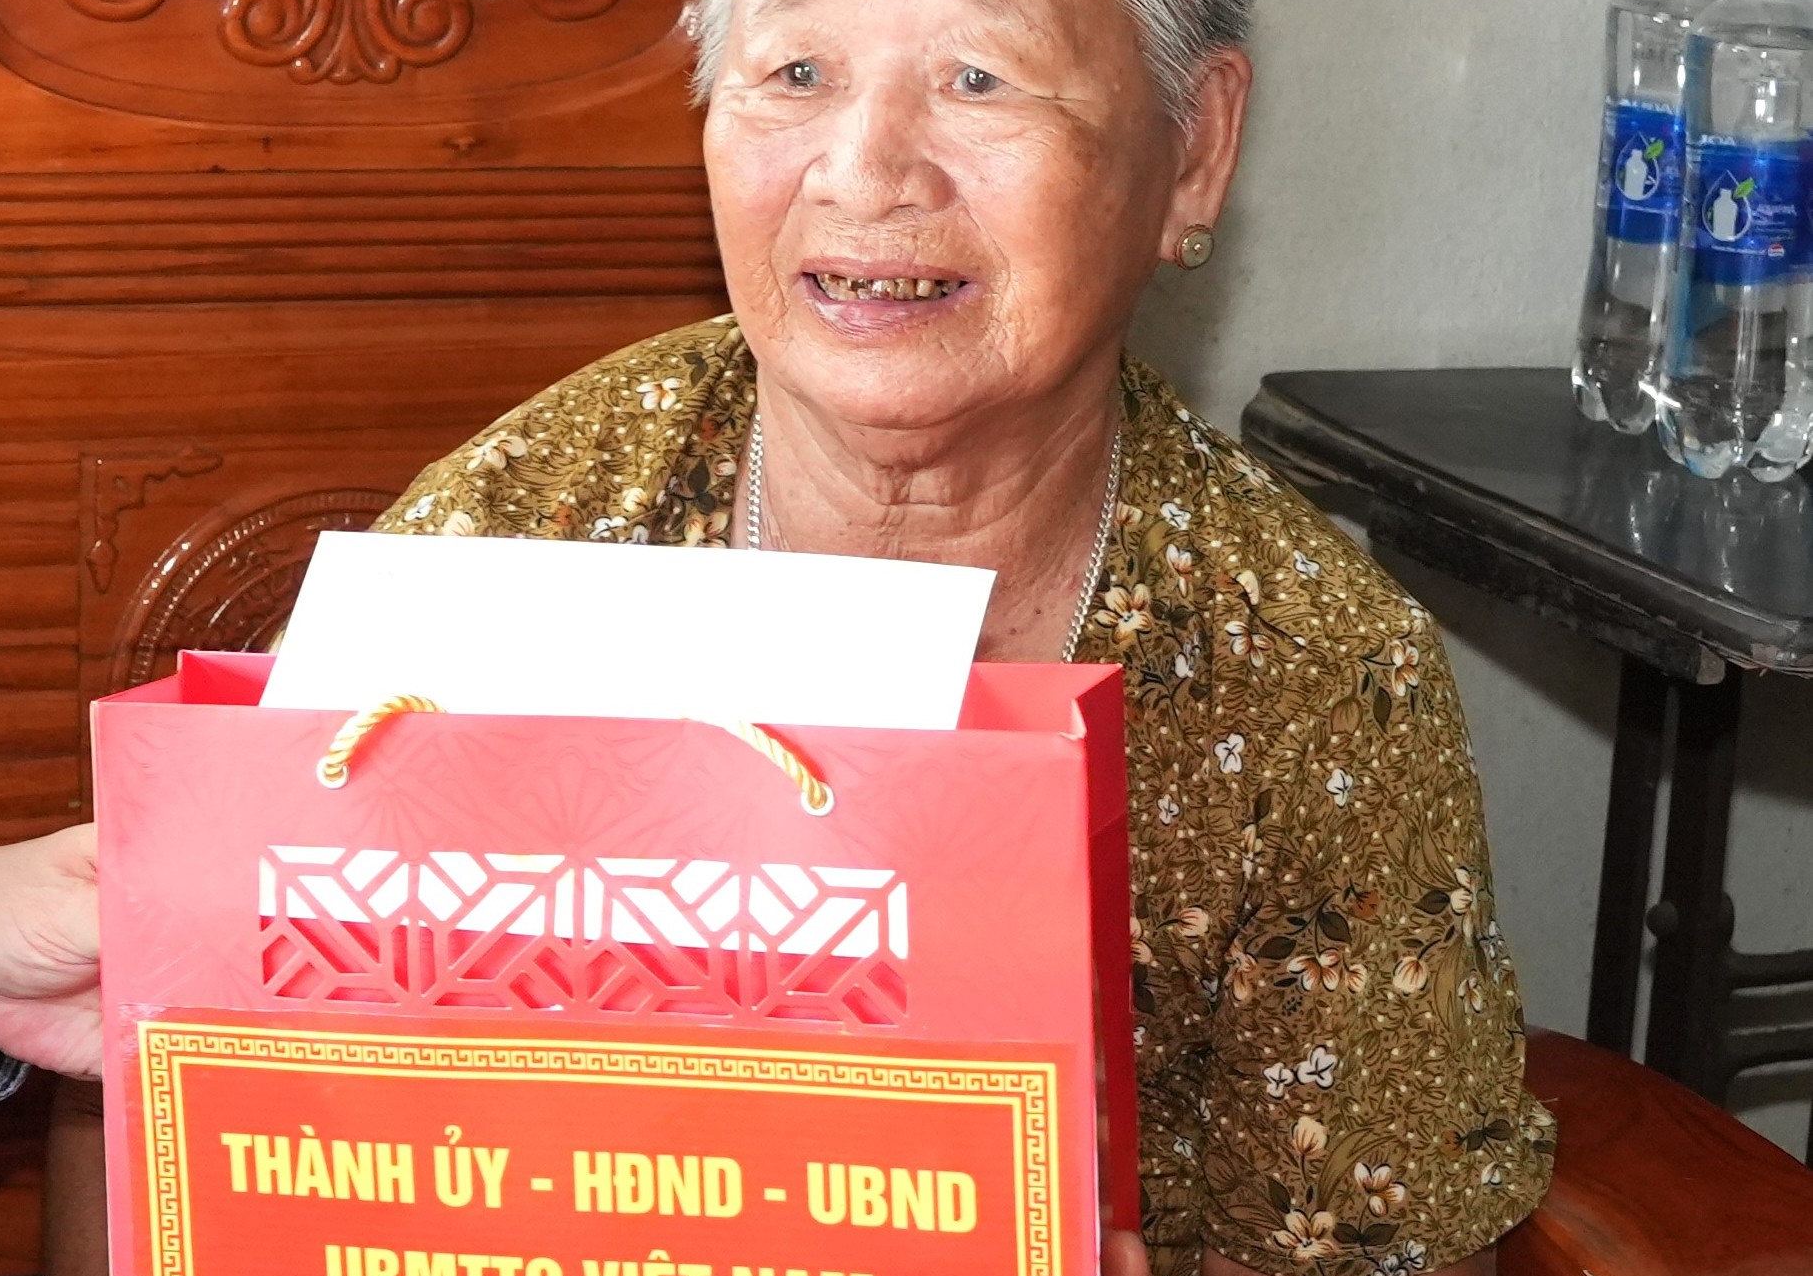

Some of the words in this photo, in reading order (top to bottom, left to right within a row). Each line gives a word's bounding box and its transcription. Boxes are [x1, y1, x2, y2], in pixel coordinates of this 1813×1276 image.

[221, 1125, 416, 1204] THÀNH
[434, 1125, 510, 1209] ỦY
[573, 1151, 743, 1218] HĐND
[807, 1161, 977, 1233] UBND
